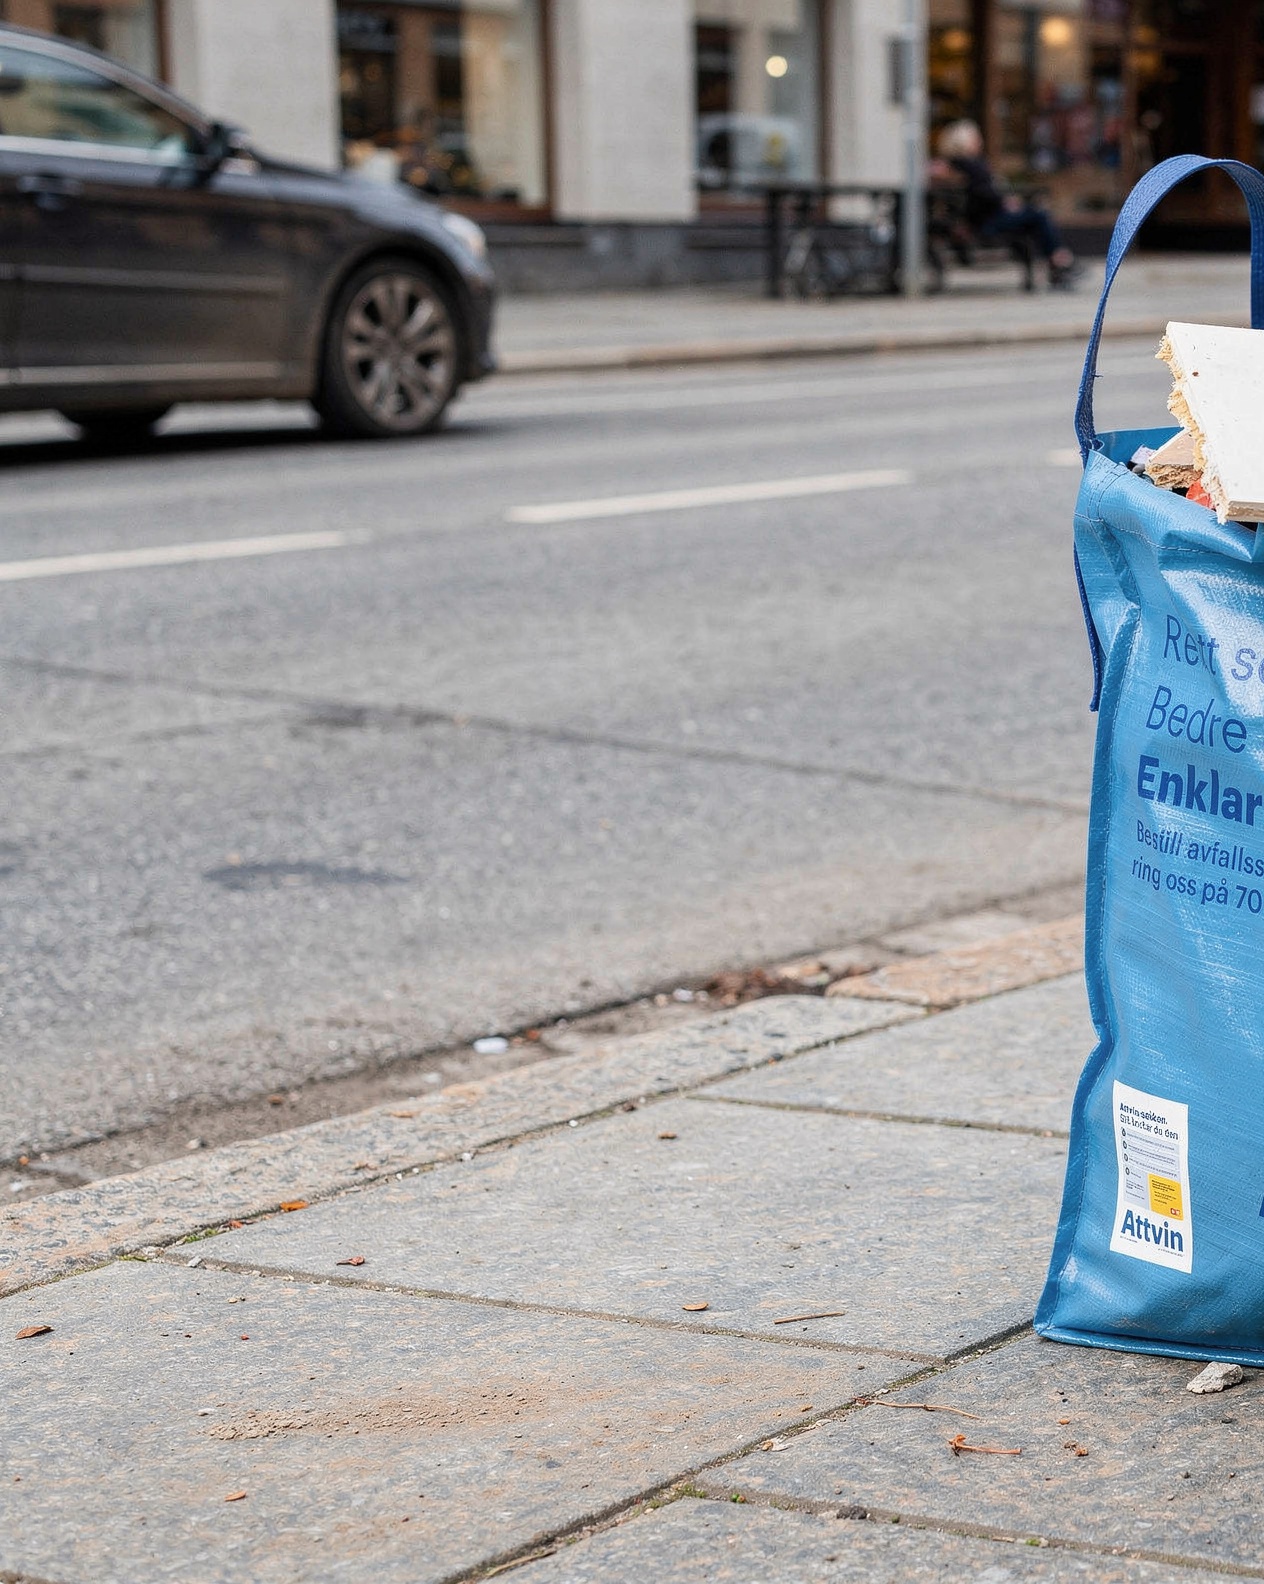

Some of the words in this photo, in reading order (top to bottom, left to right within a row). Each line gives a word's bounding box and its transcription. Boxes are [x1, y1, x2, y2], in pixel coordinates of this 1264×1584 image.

[1164, 614, 1220, 676] Rett
[1145, 684, 1248, 754] Bedre
[1136, 819, 1183, 857] Bestill
[1131, 856, 1161, 891] ring
[1165, 872, 1197, 897] oss
[1200, 878, 1229, 905] på
[1235, 885, 1263, 914] 70
[1120, 1209, 1184, 1253] Attvin
